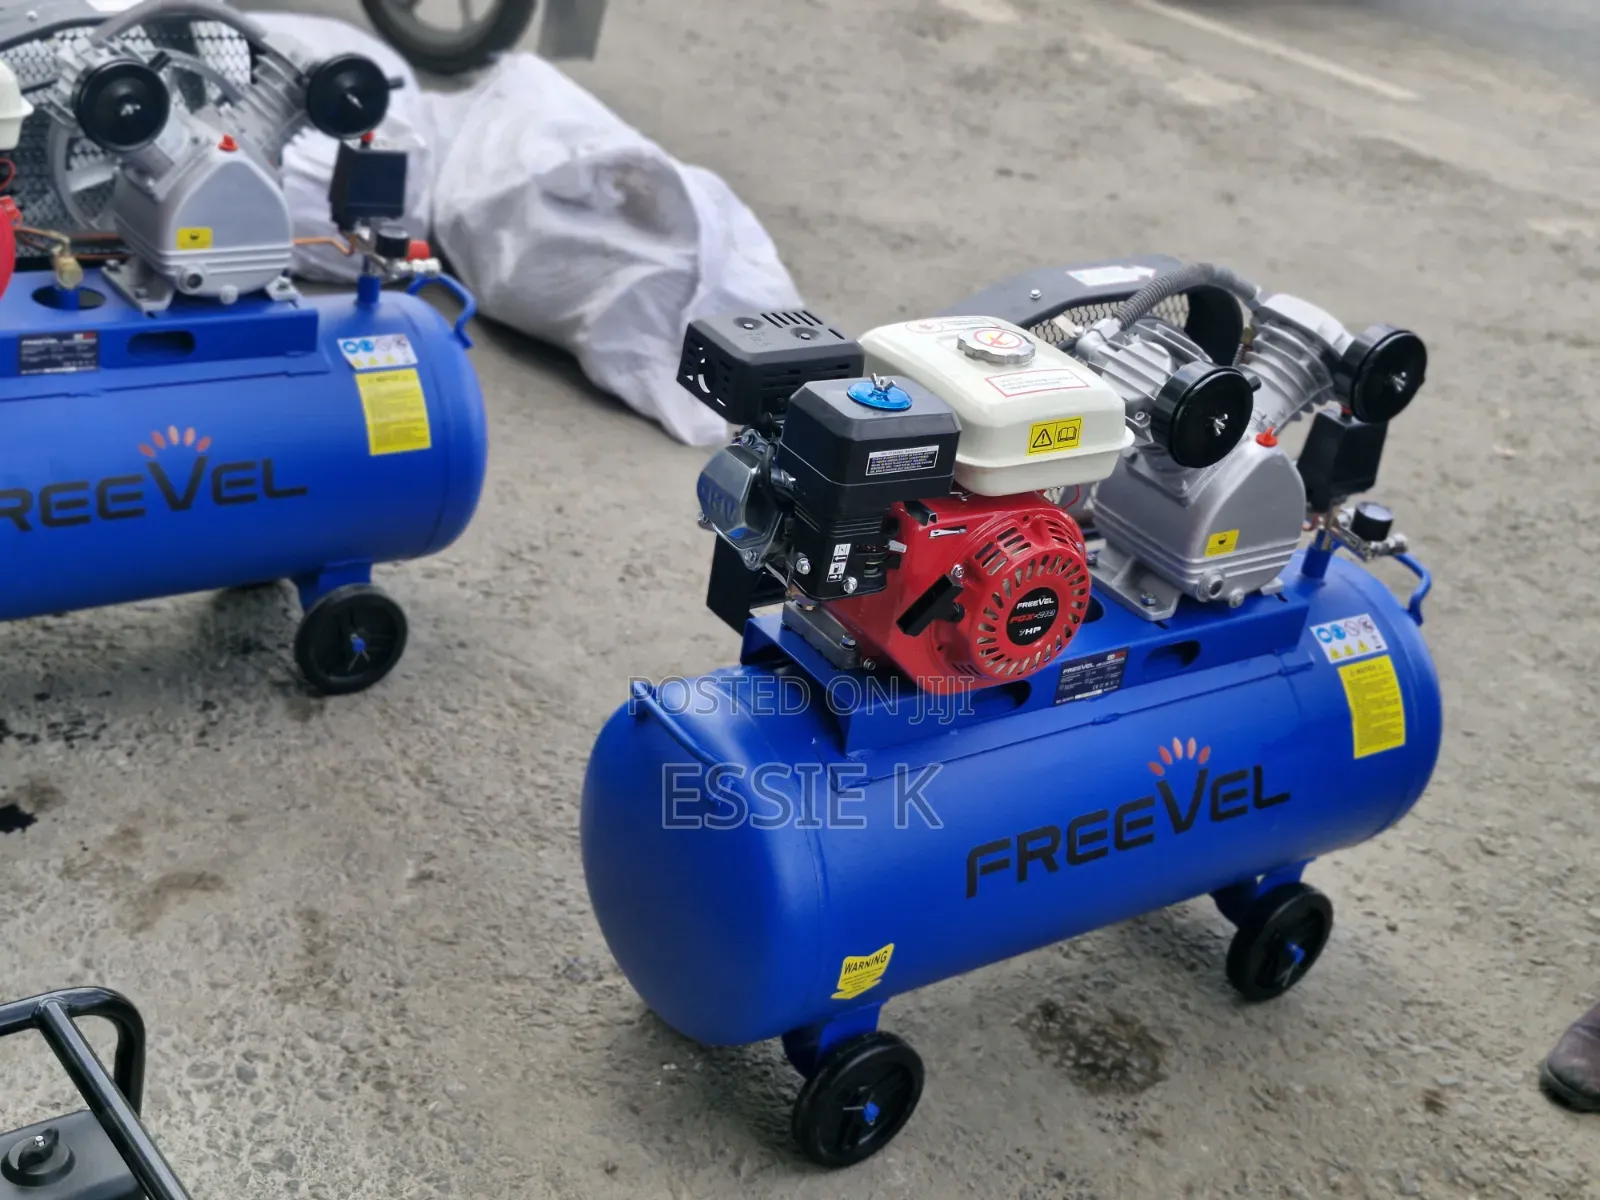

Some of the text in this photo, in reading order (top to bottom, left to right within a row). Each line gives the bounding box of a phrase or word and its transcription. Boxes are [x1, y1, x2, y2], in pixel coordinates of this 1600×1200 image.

[0, 455, 309, 533] REEVEL
[1016, 597, 1055, 610] FREEVEL
[966, 764, 1291, 899] FREEVEL
[844, 950, 888, 976] WARNING
